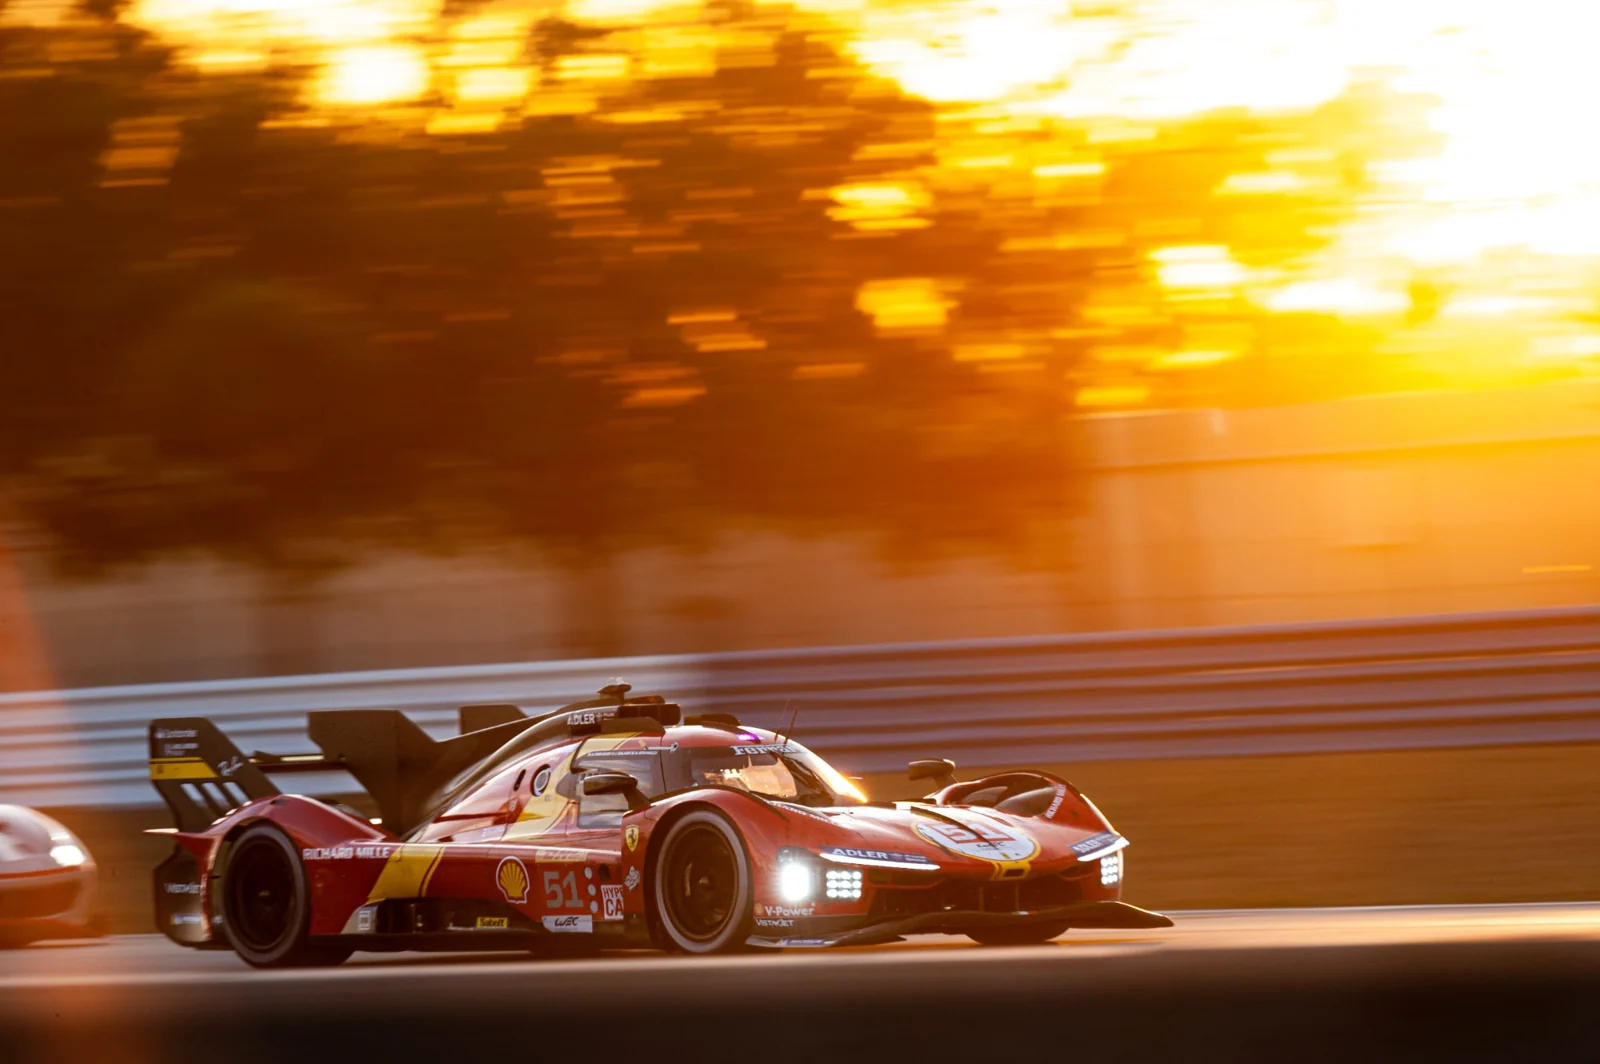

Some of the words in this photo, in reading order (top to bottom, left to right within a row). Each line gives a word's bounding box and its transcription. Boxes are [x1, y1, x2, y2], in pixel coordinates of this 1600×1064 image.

[567, 713, 595, 725] ADLER
[303, 848, 353, 860] RICHARD
[356, 847, 390, 859] MILLE
[832, 848, 888, 860] ADLER
[544, 871, 584, 908] 51
[765, 906, 815, 916] V-Power
[555, 916, 579, 926] WEC
